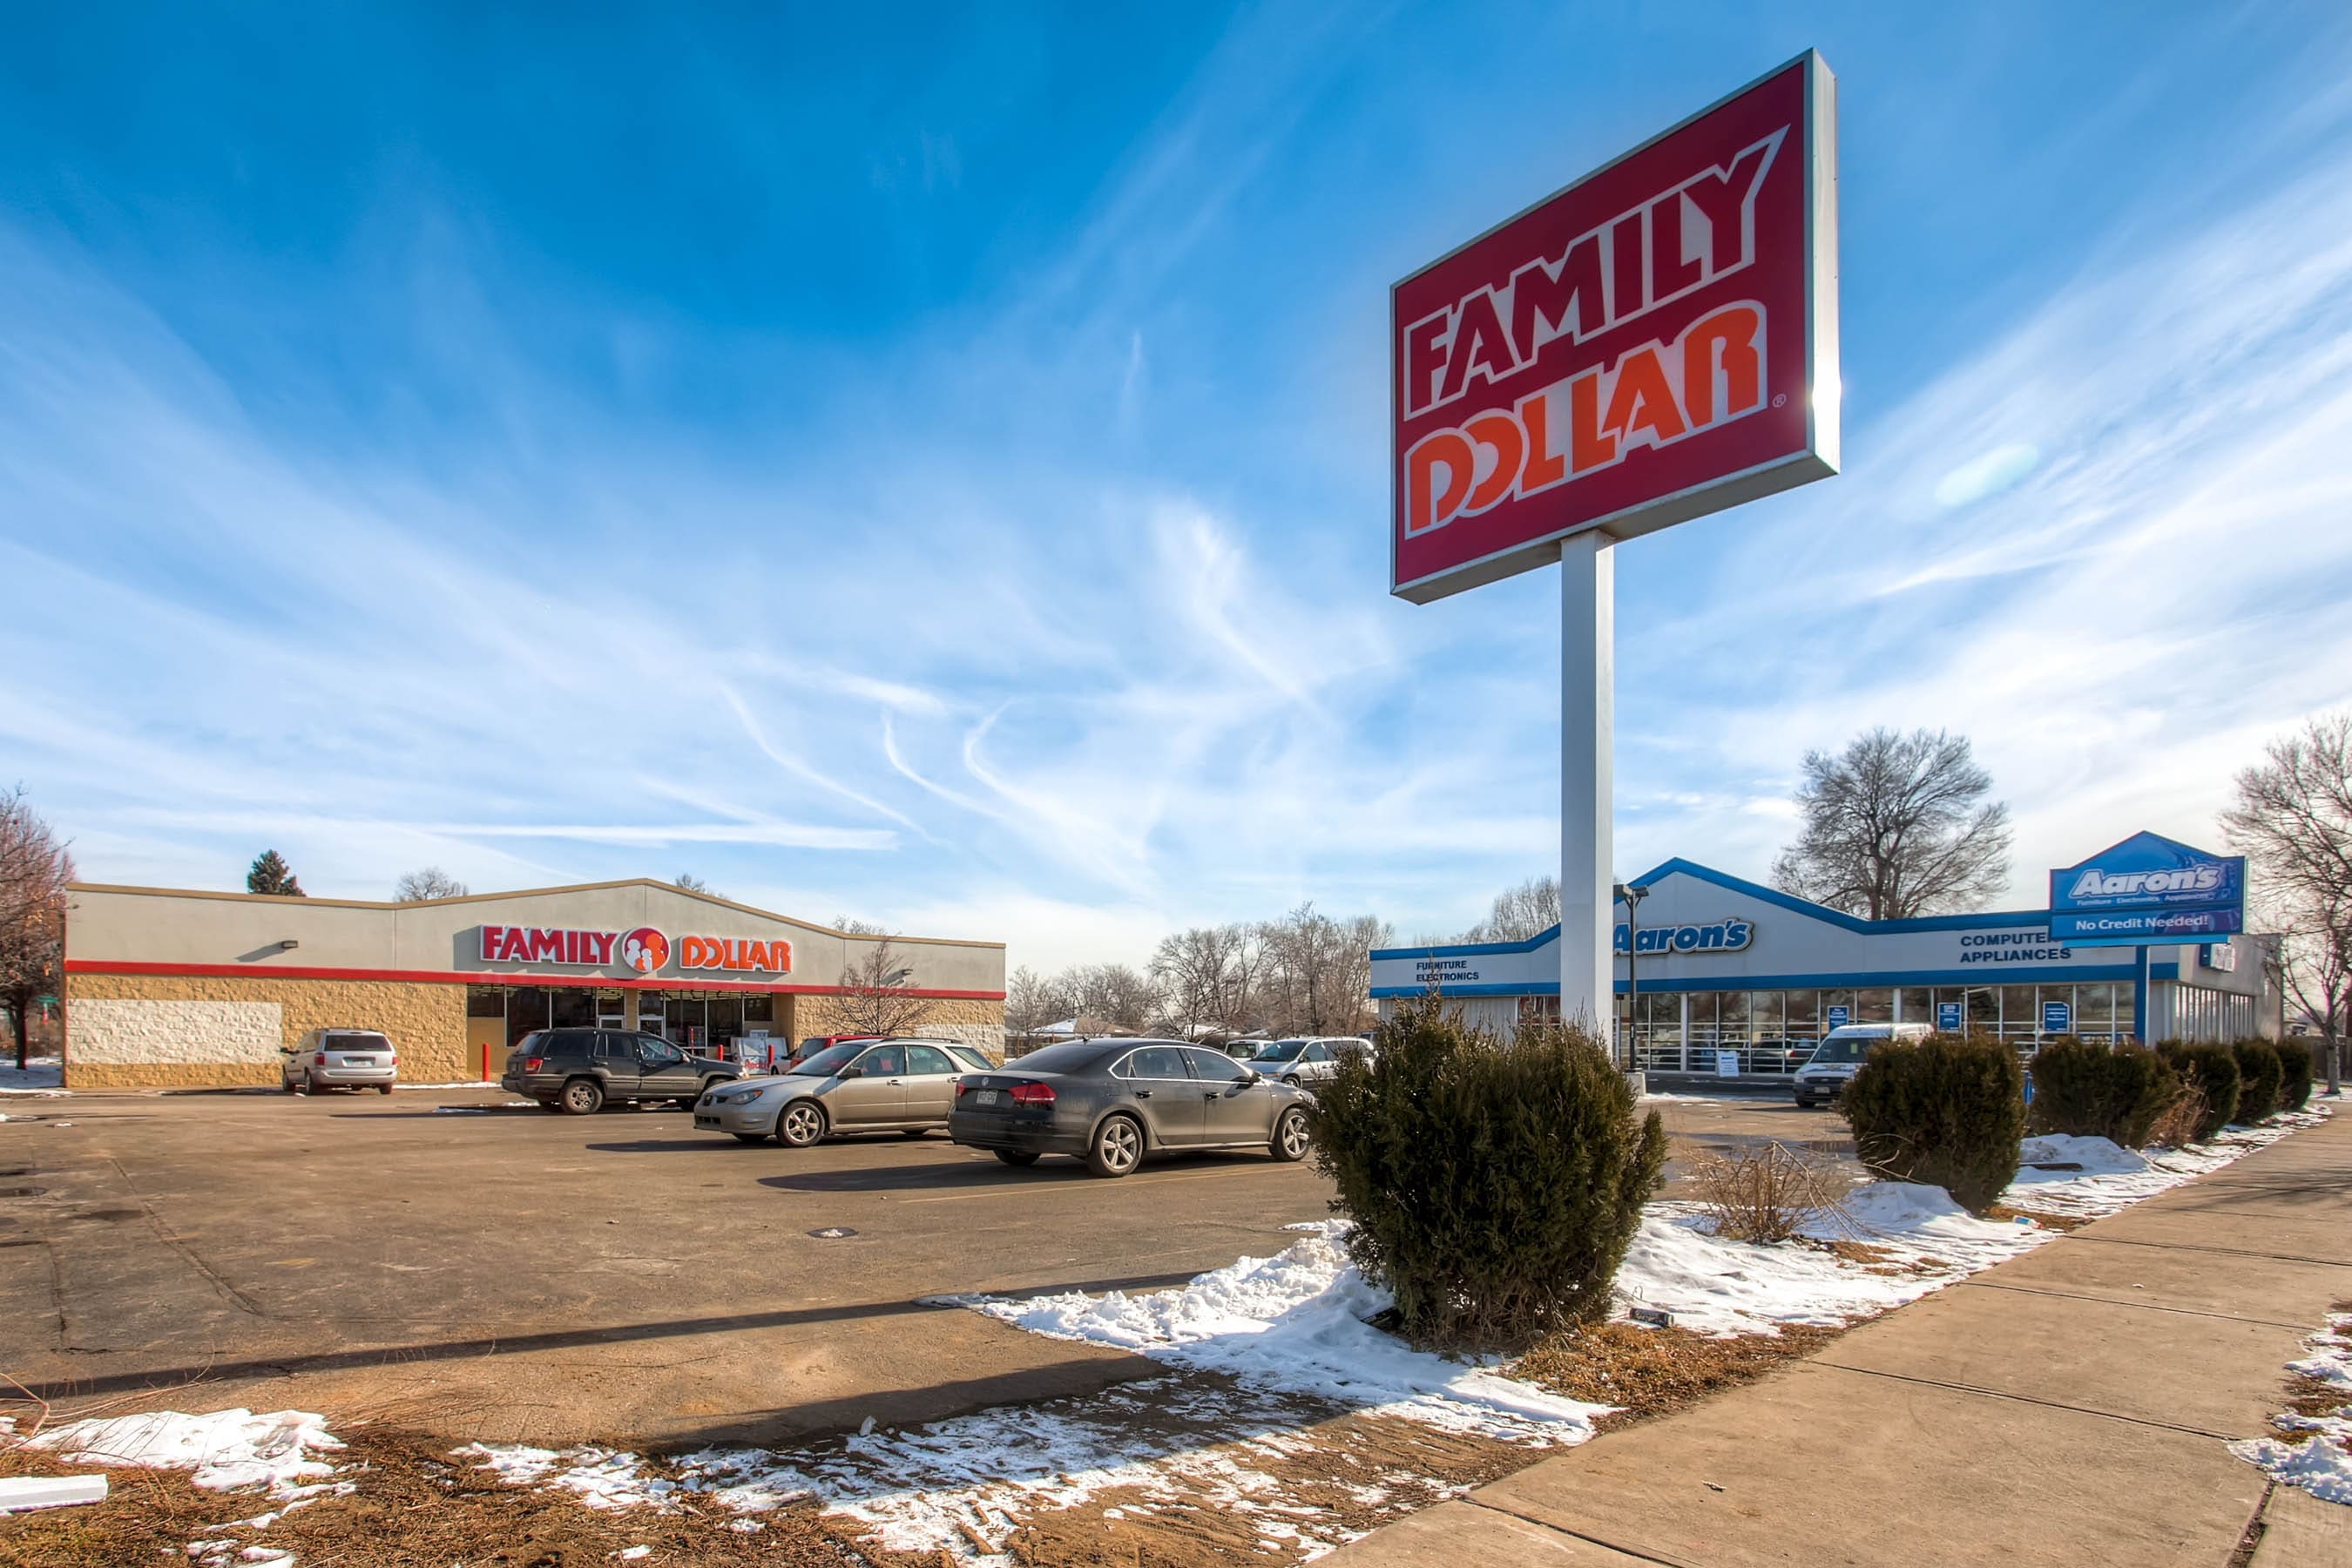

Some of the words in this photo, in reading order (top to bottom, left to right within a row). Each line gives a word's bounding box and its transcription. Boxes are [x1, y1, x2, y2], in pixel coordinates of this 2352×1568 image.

[1404, 124, 1790, 421] FAMILY
[1404, 300, 1767, 539] DOLLAR
[2069, 864, 2221, 898] Aaron's
[2076, 920, 2096, 930] No
[2099, 918, 2142, 929] Credit
[2145, 916, 2208, 928] Needed!
[482, 925, 618, 965] FAMILY
[679, 935, 792, 972] DOLLAR
[1613, 919, 1750, 954] Aaron's
[1960, 932, 2054, 946] COMPUTE
[1416, 960, 1467, 970] FURNITURE
[1960, 948, 2072, 963] APPLIANCES
[1416, 972, 1479, 982] ELECTRONICS
